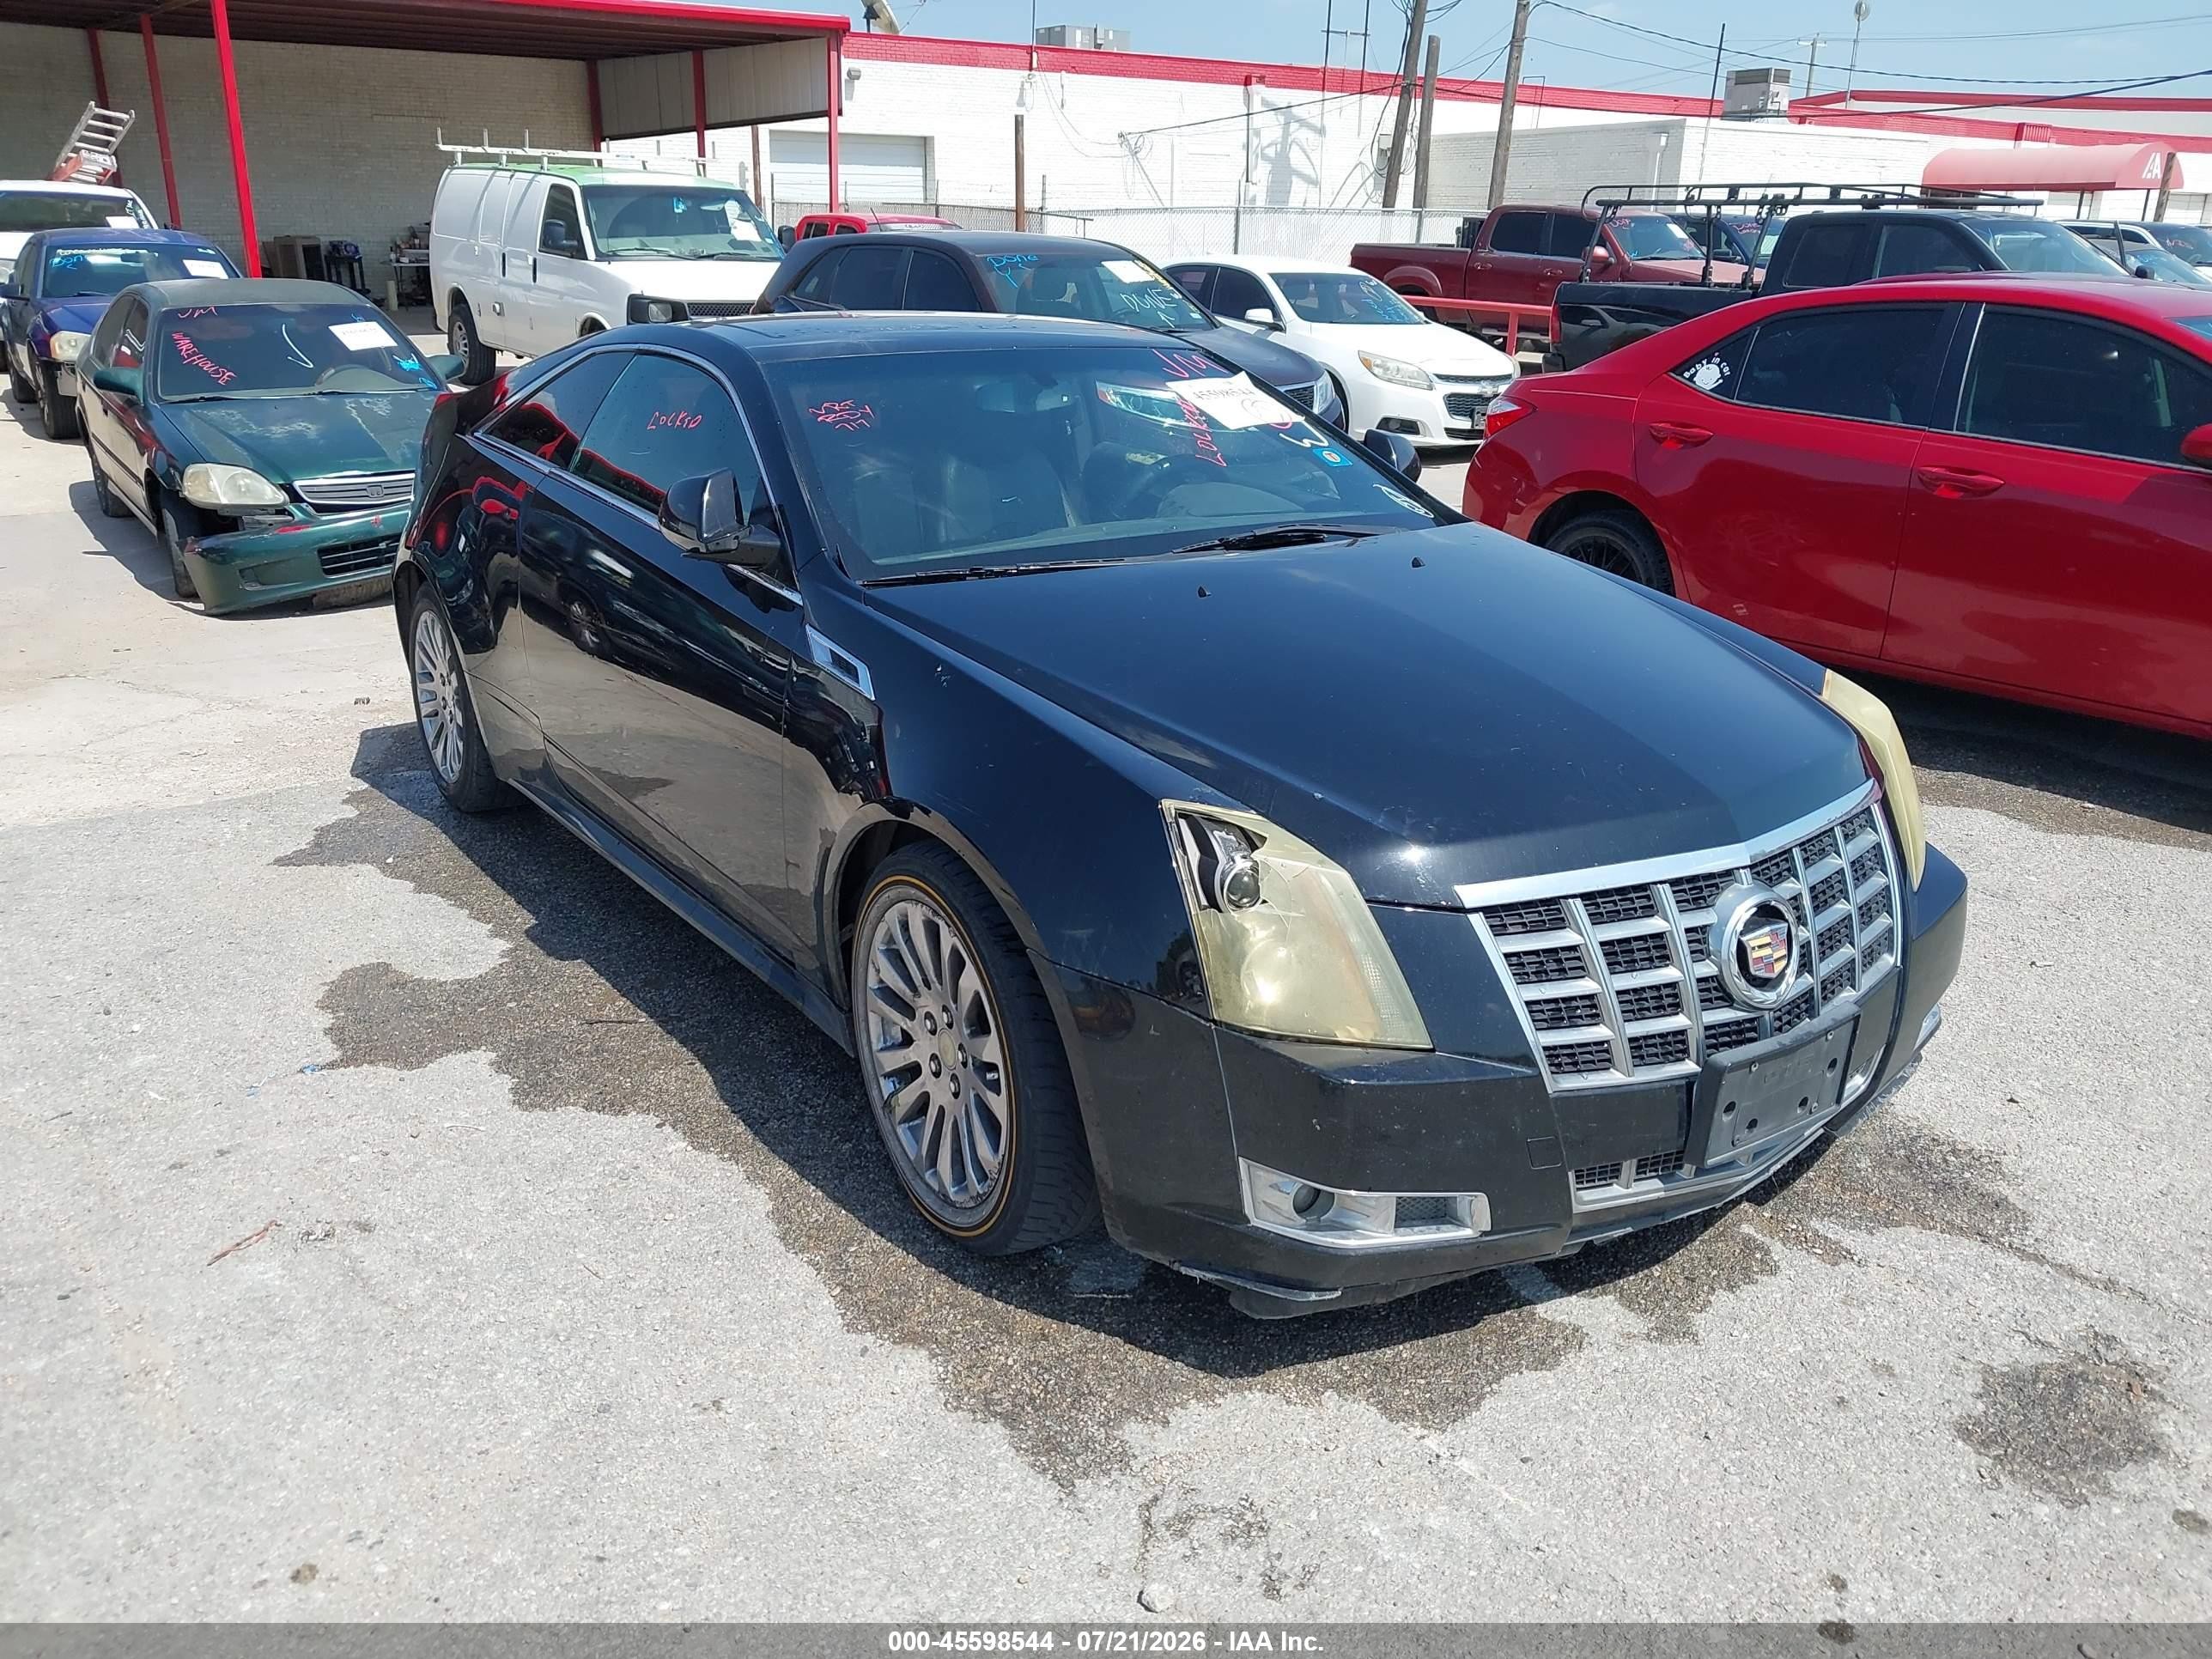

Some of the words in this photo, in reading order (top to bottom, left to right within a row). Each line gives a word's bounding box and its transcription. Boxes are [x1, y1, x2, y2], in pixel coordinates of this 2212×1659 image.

[171, 331, 238, 386] WAREHOUSE
[1683, 358, 1708, 379] Baby
[1720, 362, 1731, 376] car
